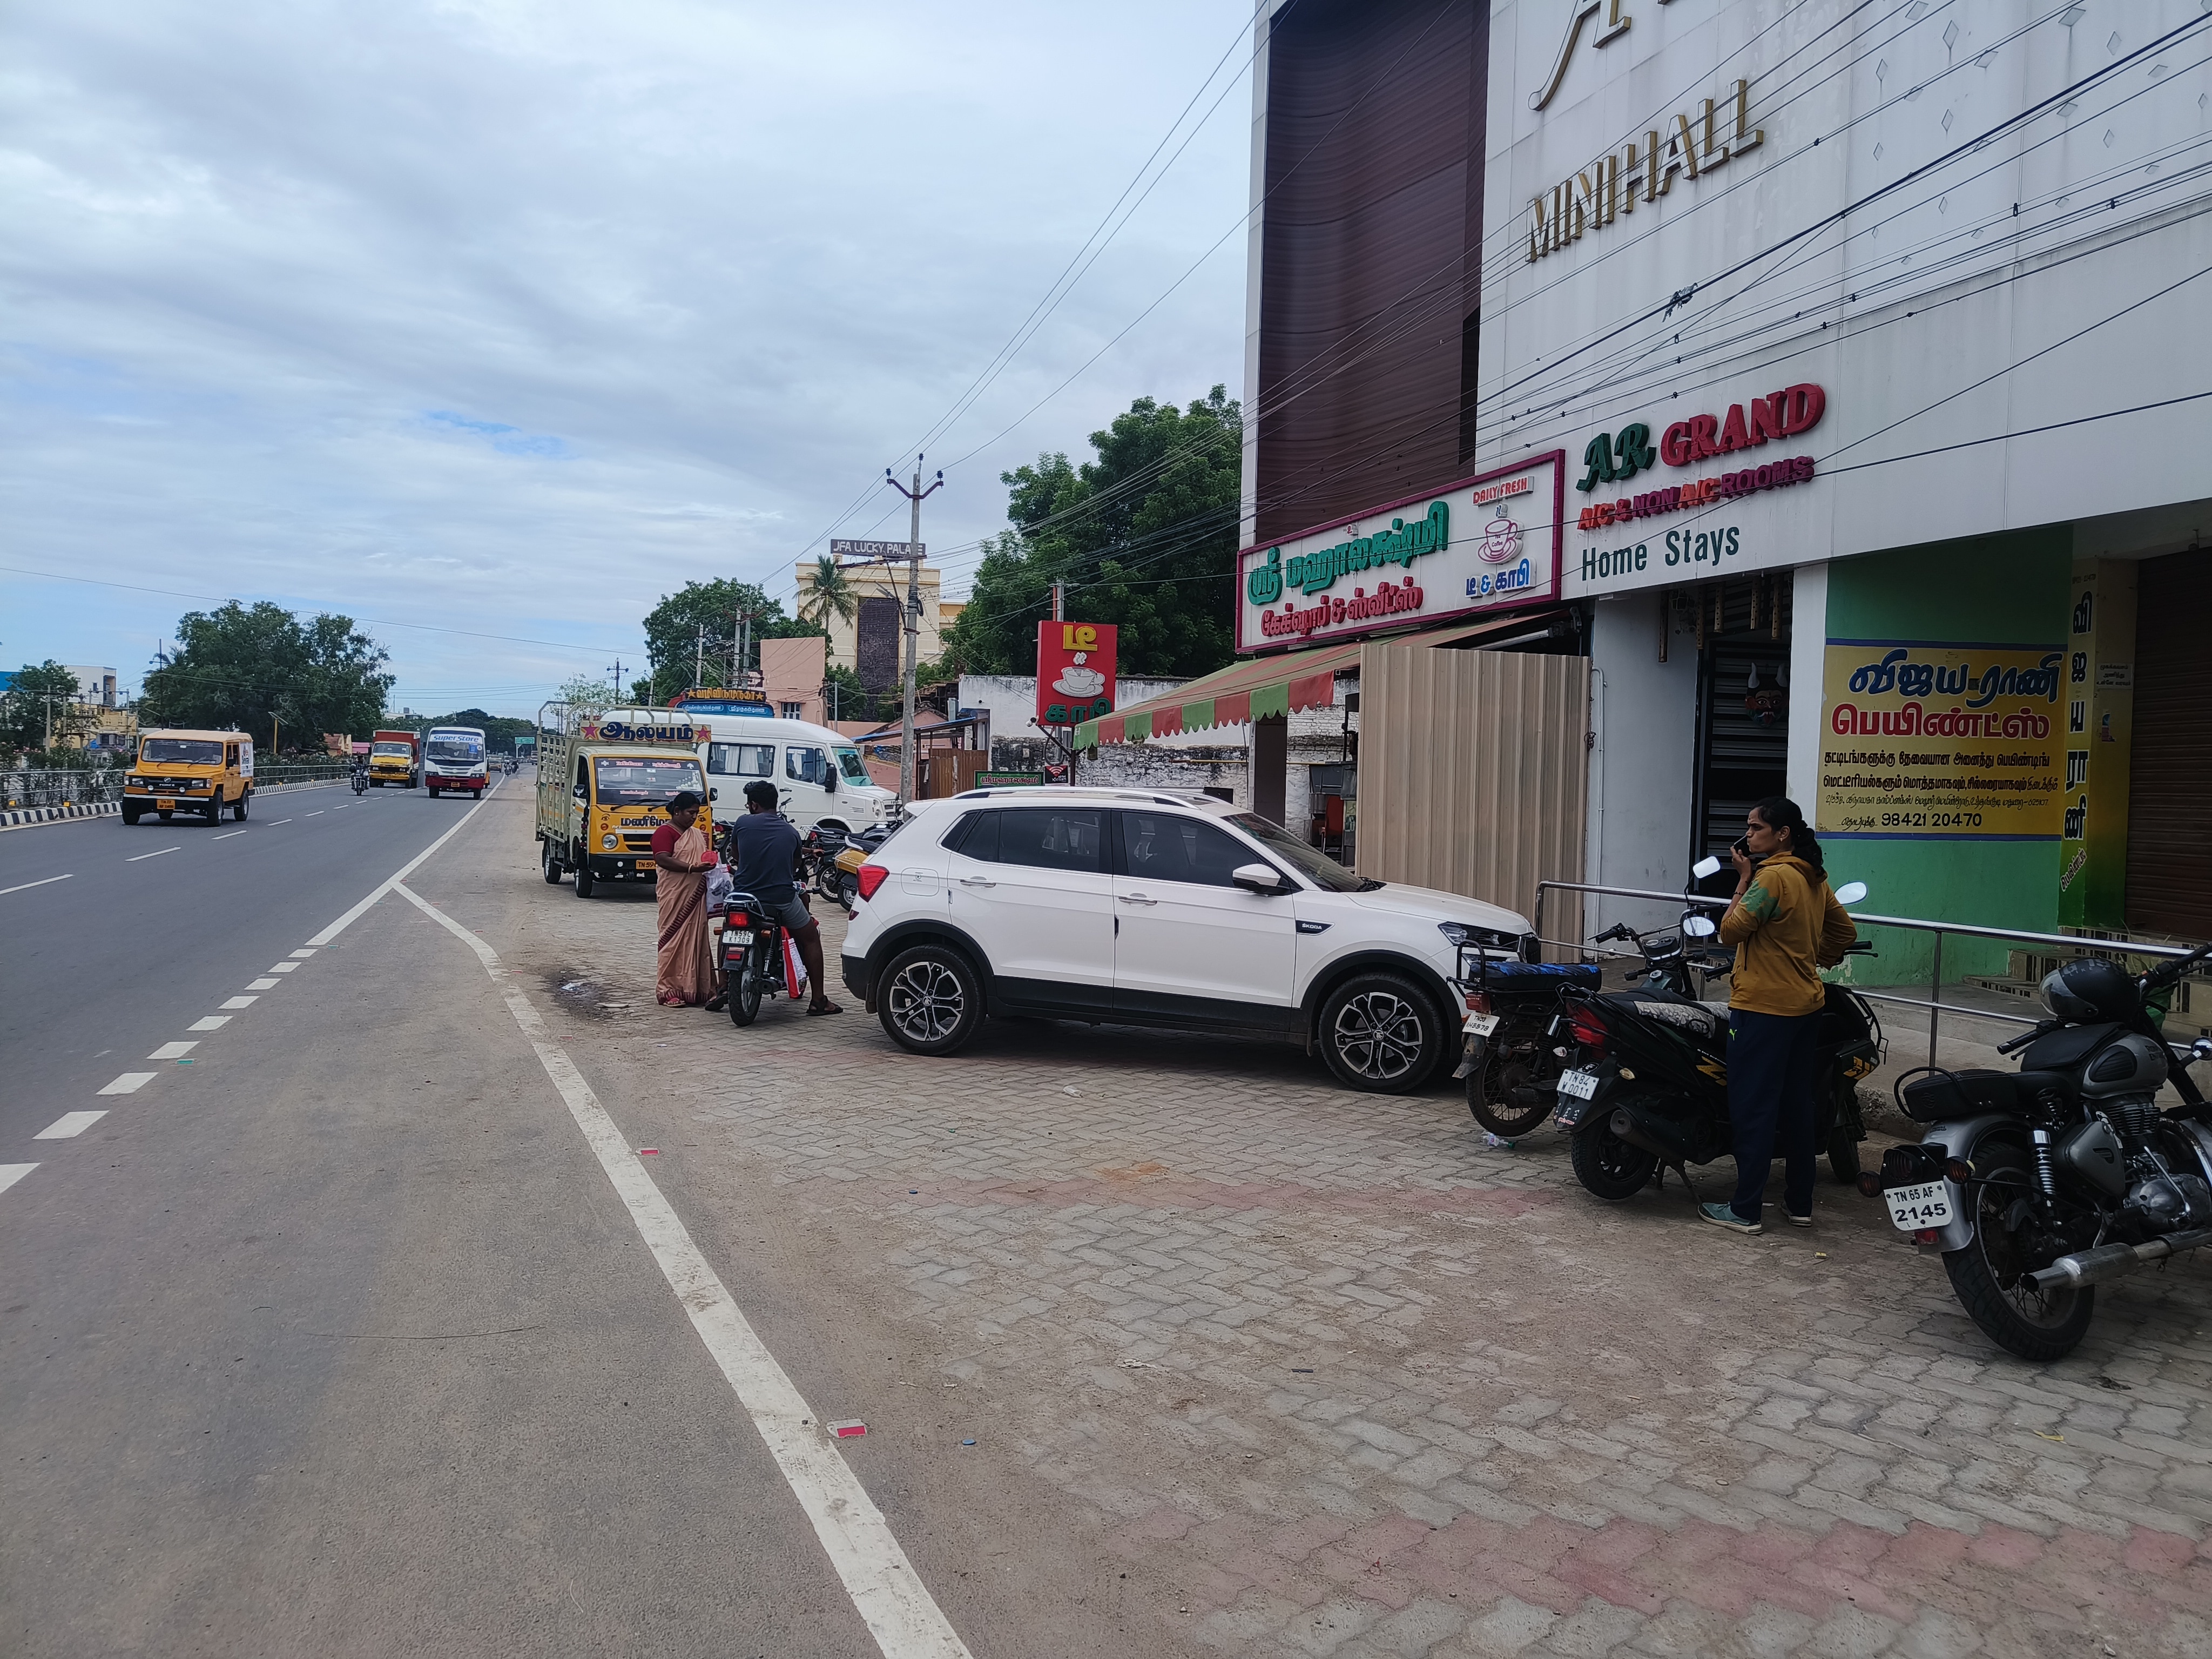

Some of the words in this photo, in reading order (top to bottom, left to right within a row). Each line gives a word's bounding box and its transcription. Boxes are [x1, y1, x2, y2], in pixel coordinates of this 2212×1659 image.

[1576, 423, 1656, 491] AR
[1661, 383, 1826, 466] GRAND
[1473, 486, 1498, 505] DAILY
[1500, 477, 1527, 496] FRESH
[1633, 487, 1681, 517] NON
[1721, 456, 1815, 498] ROOMS
[833, 541, 852, 551] JFA
[854, 542, 885, 554] LUCKY
[887, 543, 923, 555] PALAE
[1582, 544, 1647, 582] Home
[1665, 527, 1739, 566] Stays
[1480, 575, 1491, 592] &
[1495, 558, 1529, 590] காபி
[599, 721, 694, 741] ஆலயம்
[1832, 701, 2051, 739] பெயிண்ட்ஸ்
[1899, 751, 1950, 766] தேவையான
[1953, 752, 1994, 768] அனைத்து
[1997, 751, 2050, 770] பெயிண்டிங்
[1881, 813, 1926, 827] 98421
[1932, 813, 1982, 827] 20470
[1894, 1191, 1907, 1203] TN
[1908, 1189, 1920, 1200] 65
[1923, 1186, 1933, 1198] AF
[1894, 1203, 1946, 1222] 2145
